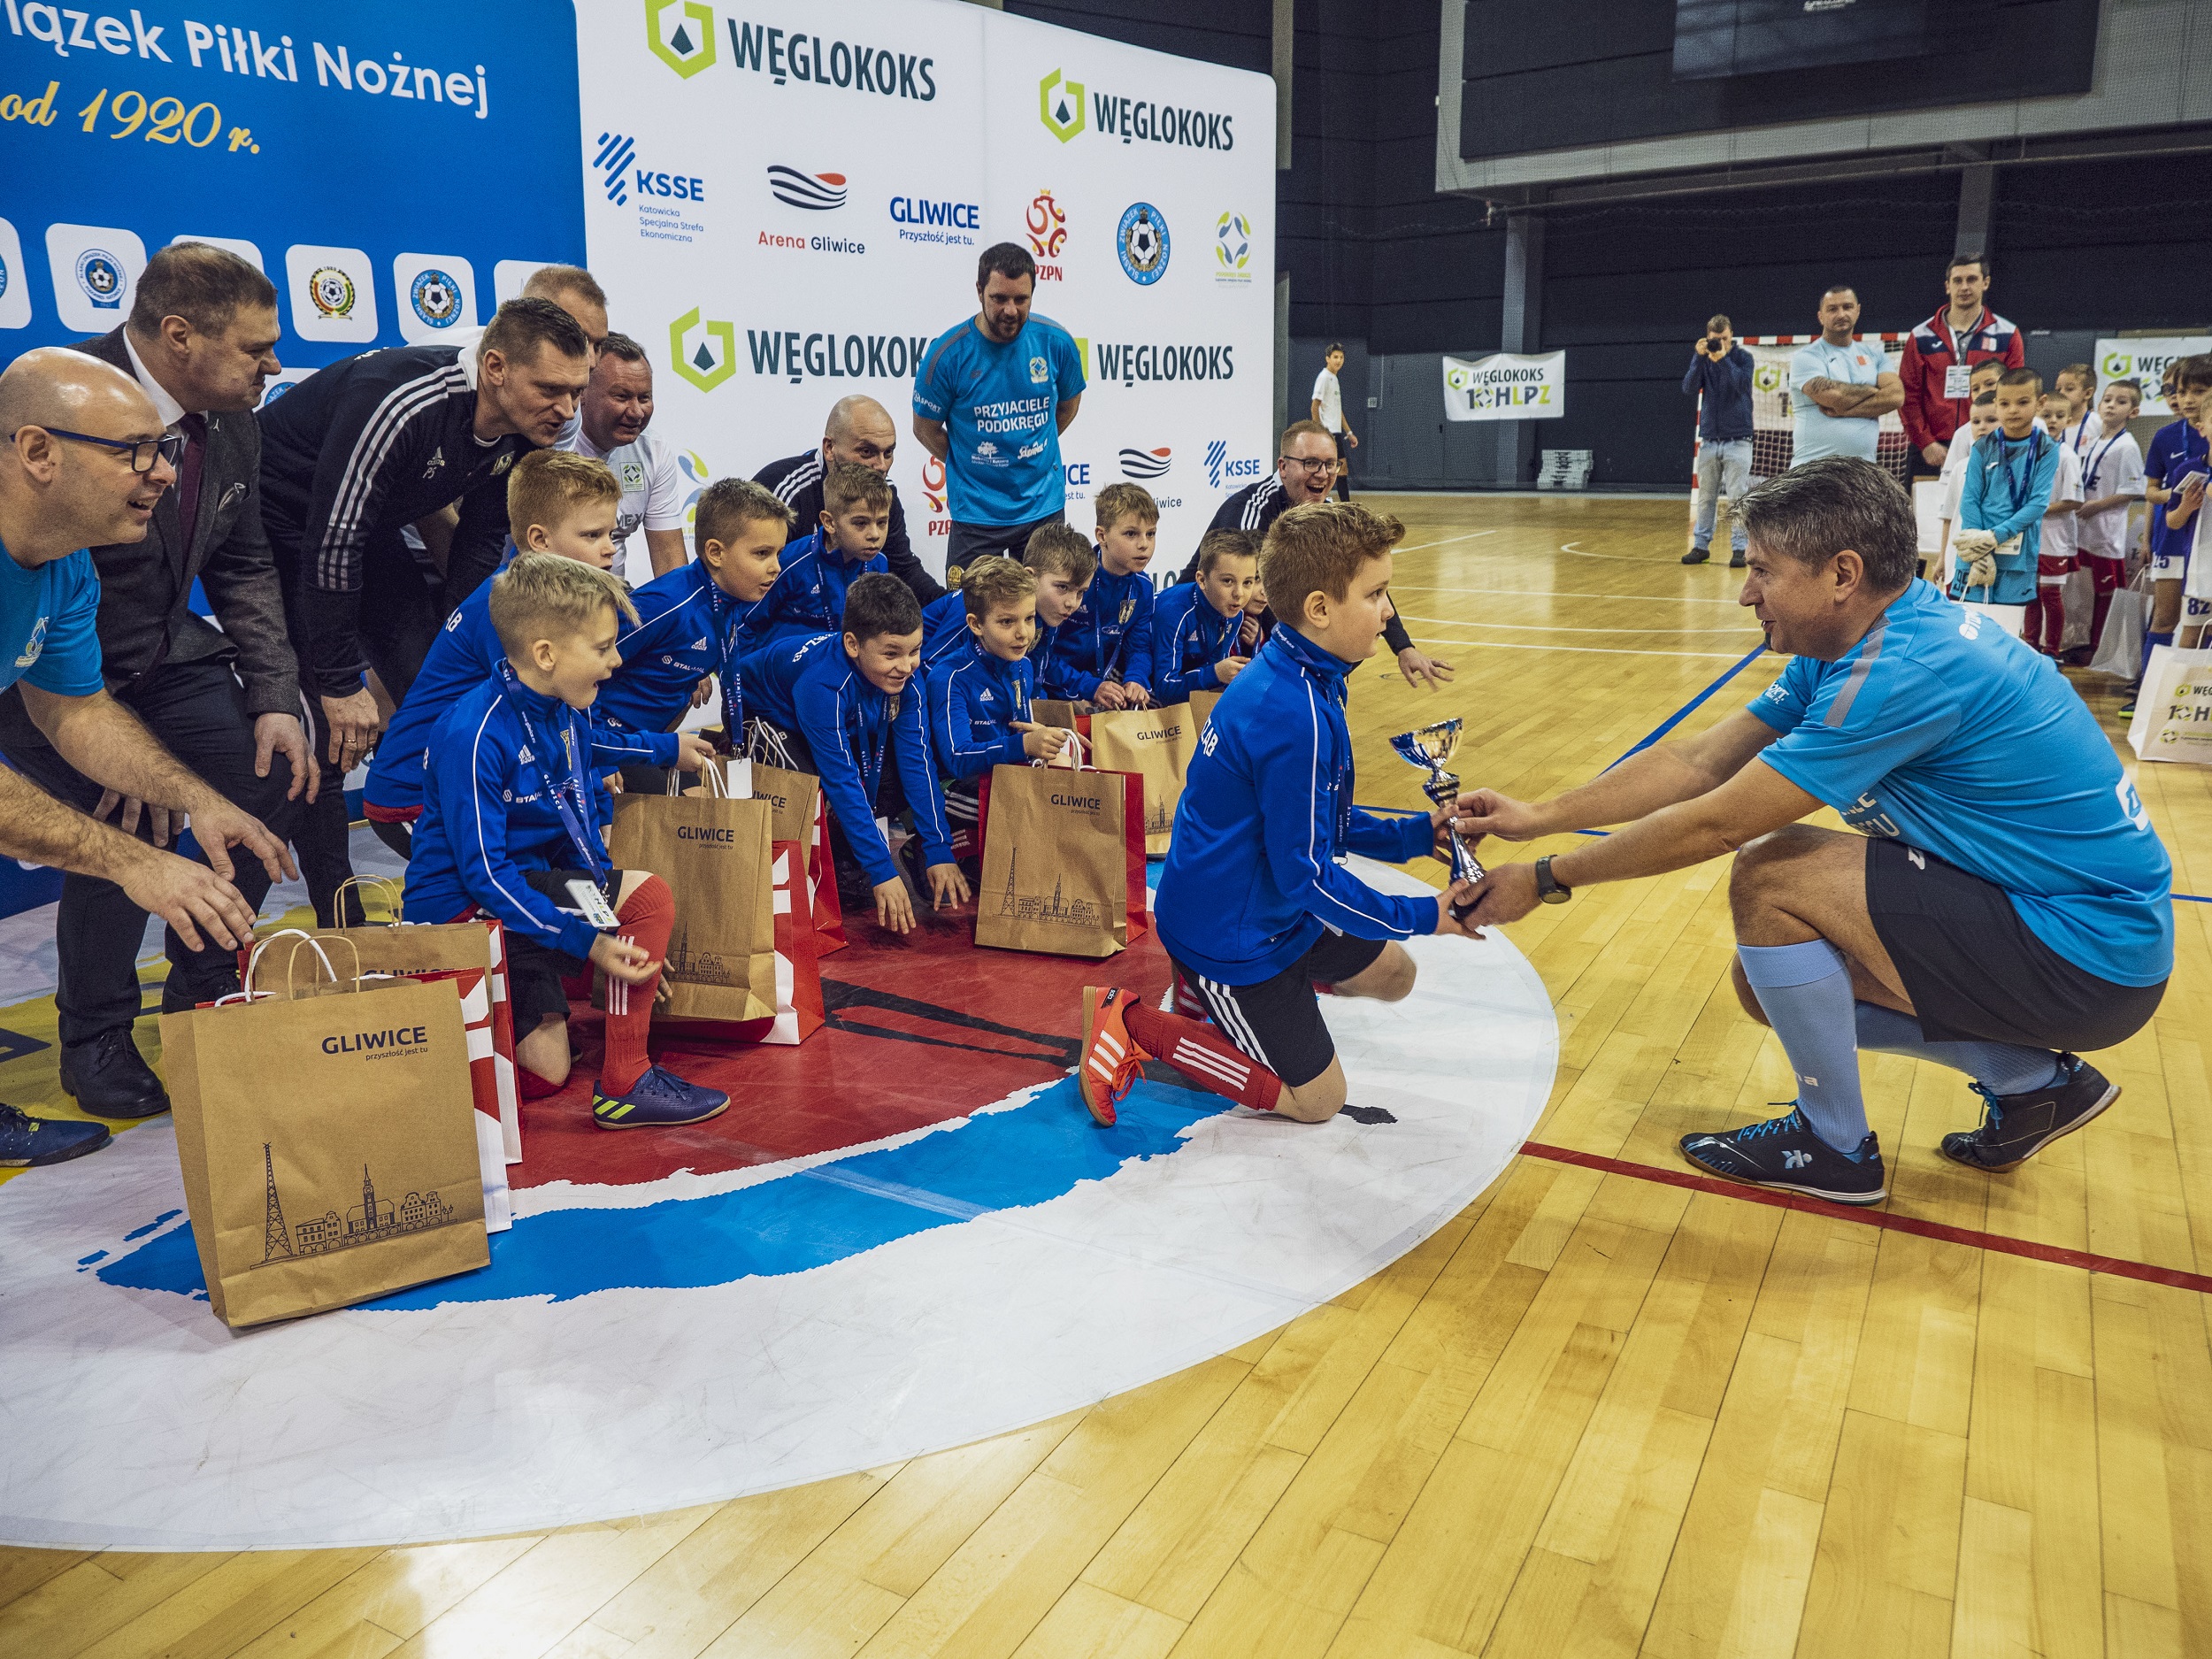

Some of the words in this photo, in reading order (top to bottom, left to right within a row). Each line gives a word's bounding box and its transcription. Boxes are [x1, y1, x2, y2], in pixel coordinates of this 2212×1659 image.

[183, 20, 298, 82] Piłki
[313, 42, 488, 119] Nożnej
[727, 18, 936, 102] WĘGLOKOKS
[0, 81, 60, 127] od
[78, 88, 221, 148] 1920
[227, 126, 260, 154] r.
[1094, 92, 1233, 150] WĘGLOKOKS
[636, 169, 704, 202] KSSE
[639, 204, 680, 217] Katowicka
[889, 196, 980, 229] GLIWICE
[639, 217, 679, 229] Specjalna
[680, 221, 704, 232] Strefa
[641, 229, 693, 242] Ekonomiczna
[758, 231, 805, 249] Arena
[810, 236, 865, 254] Gliwice
[899, 229, 944, 243] Przyszłość
[944, 234, 962, 245] jest
[1097, 343, 1233, 388] WĘGLOKOKS
[1472, 368, 1544, 386] WĘGLOKOKS
[974, 396, 1050, 418] PRZYJACIELE
[977, 412, 1049, 434] PODOKRĘGU
[1225, 459, 1260, 477] KSSE
[2187, 598, 2211, 616] 82
[1136, 725, 1182, 741] GLIWICE
[1050, 794, 1102, 810] GLIWICE
[677, 826, 735, 843] GLIWICE
[321, 1025, 428, 1055] GLIWICE
[365, 1048, 404, 1061] przyszłość
[403, 1047, 419, 1056] jest
